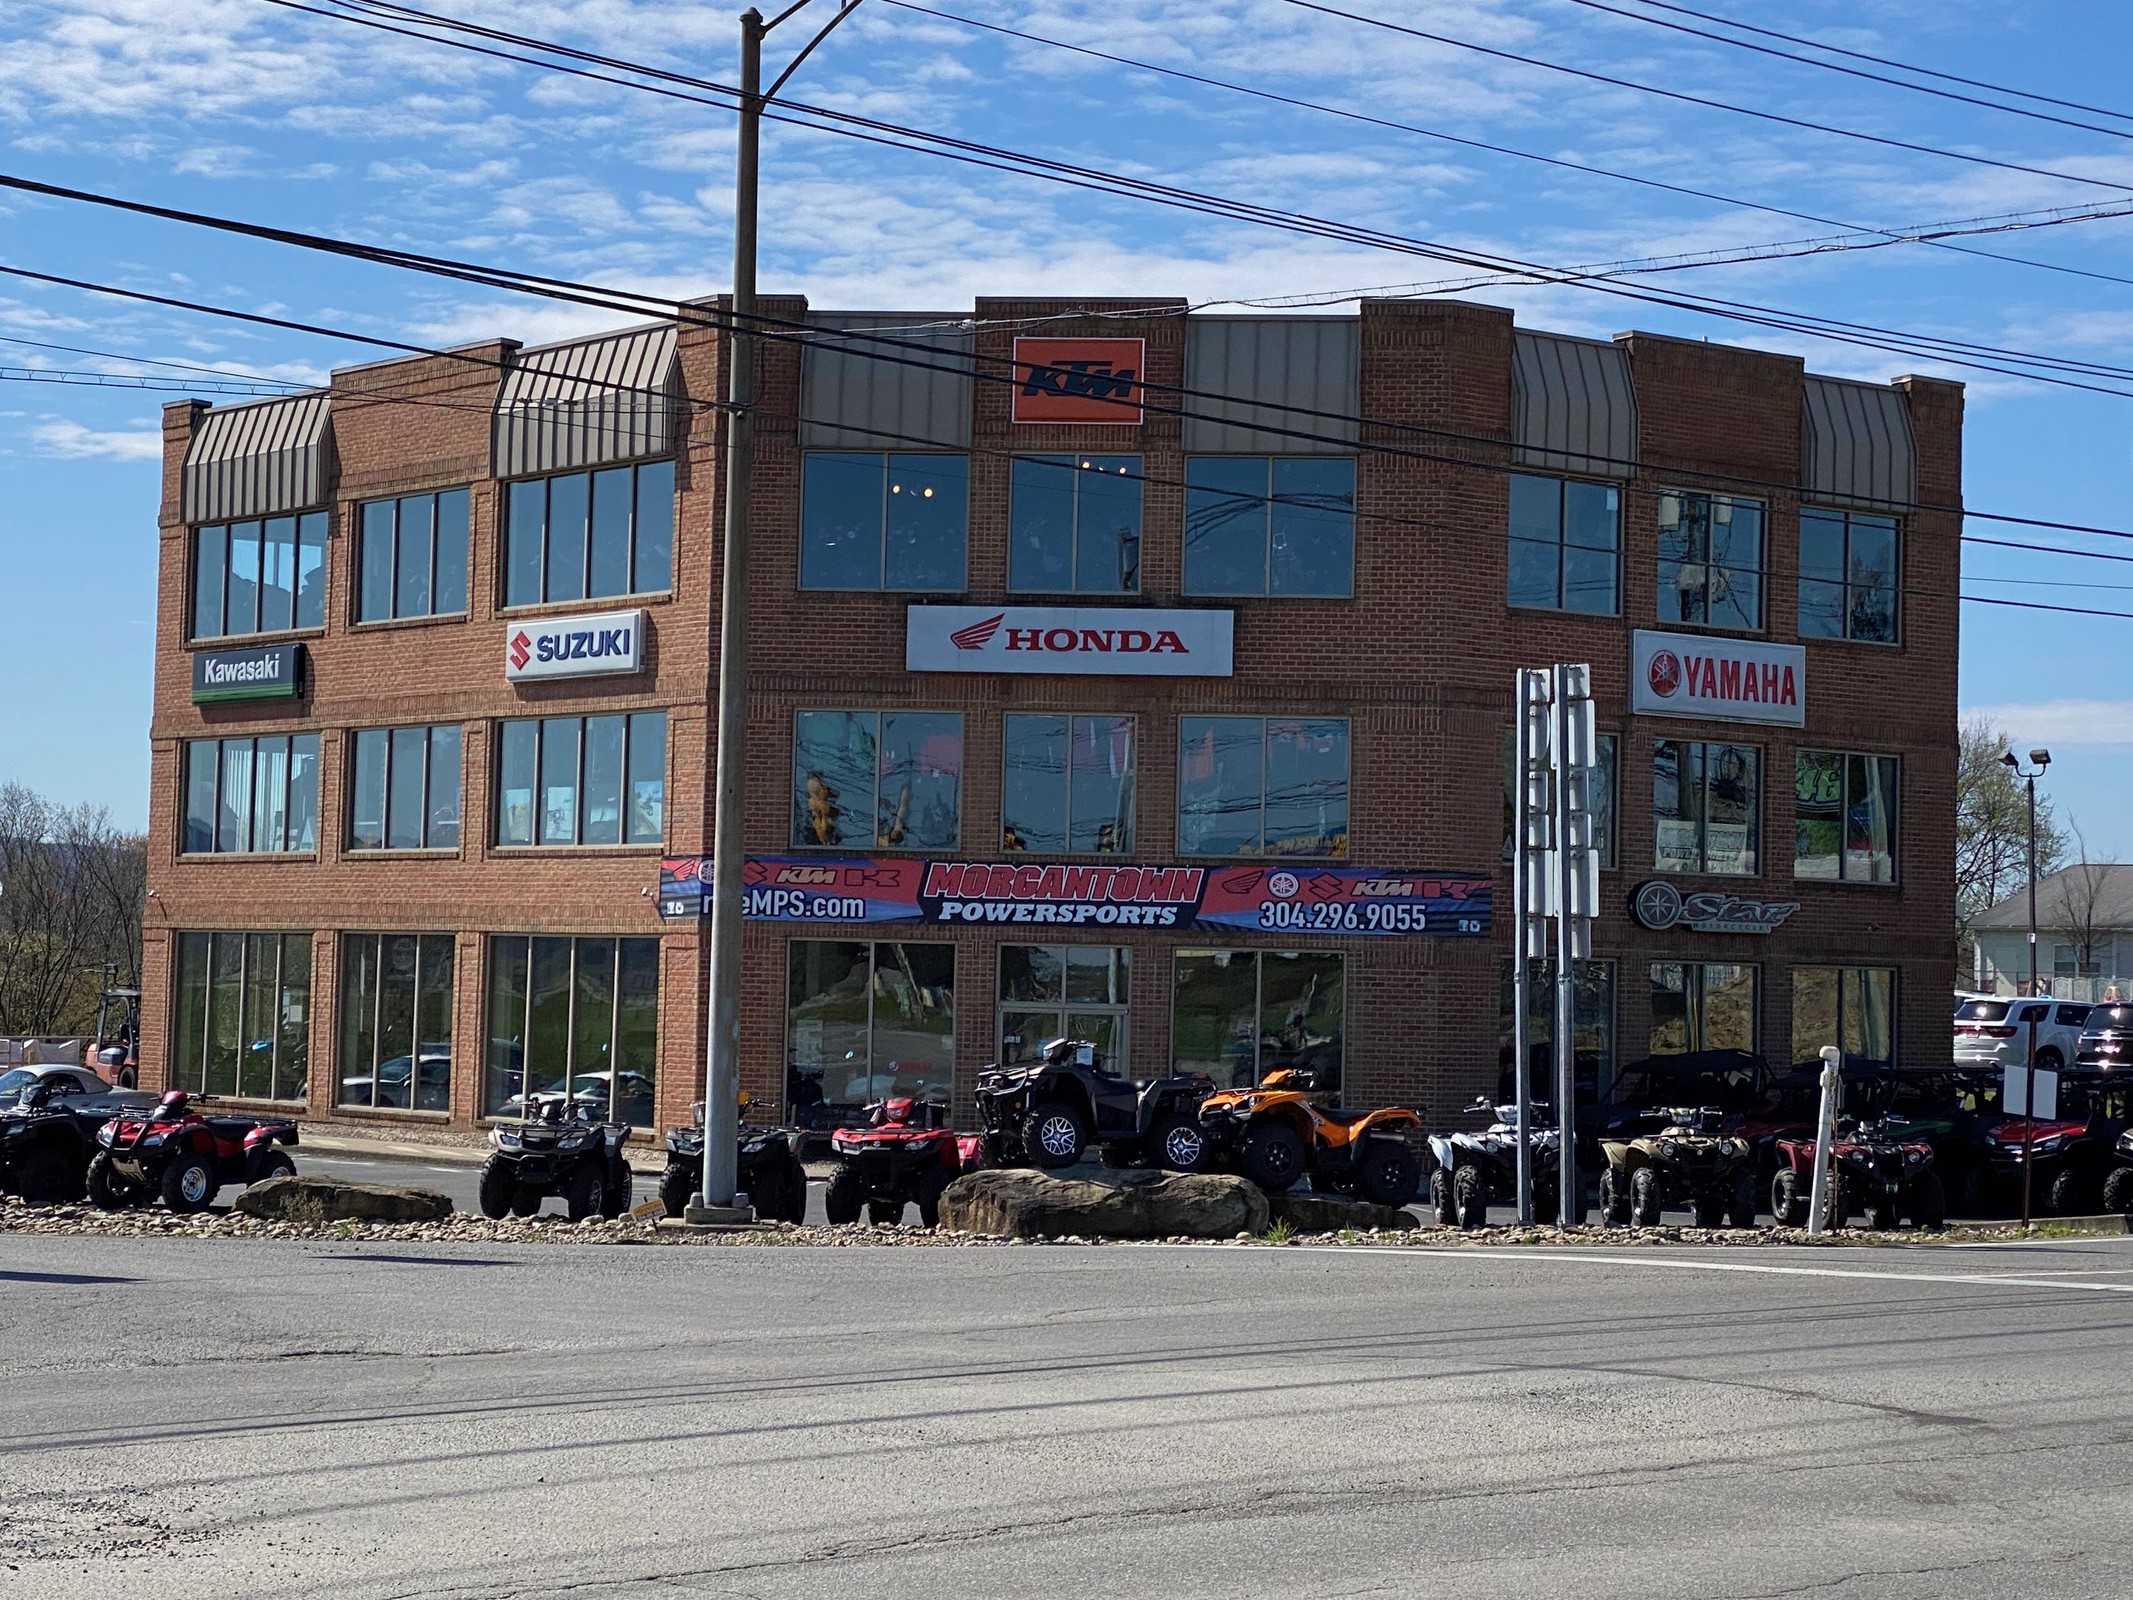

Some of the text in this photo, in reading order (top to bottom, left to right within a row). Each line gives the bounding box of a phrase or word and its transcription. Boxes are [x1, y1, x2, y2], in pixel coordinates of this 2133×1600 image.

[1021, 360, 1136, 398] KTM
[536, 628, 631, 662] SUZUKI
[1004, 628, 1190, 654] HONDA
[204, 653, 280, 684] Kawasaki
[1683, 655, 1797, 706] YAMAHA
[774, 865, 838, 884] KTM
[923, 862, 1205, 903] MORGANTOWN
[1351, 878, 1413, 897] KTM
[703, 889, 864, 918] reMPS.com
[938, 901, 1178, 925] POWERSPORTS
[1260, 901, 1426, 930] 304.296.9055
